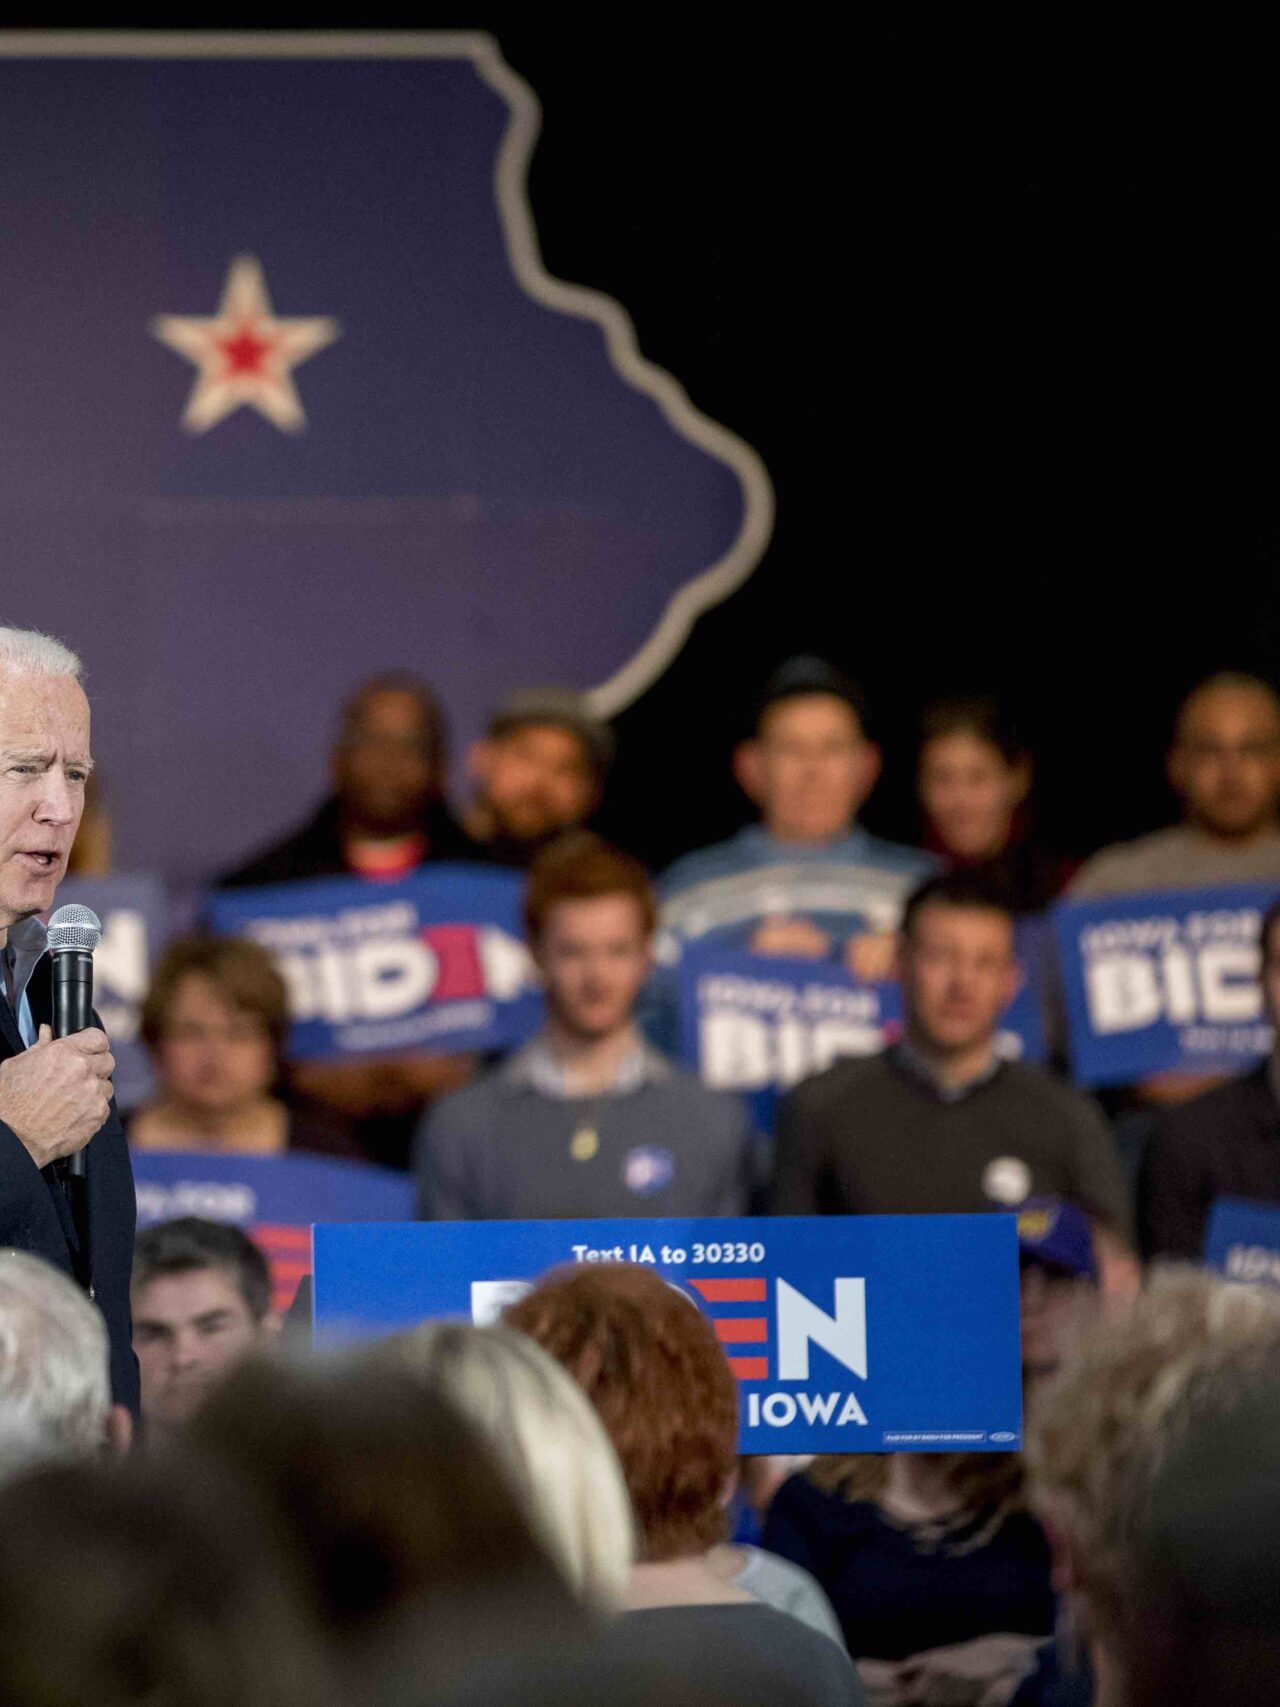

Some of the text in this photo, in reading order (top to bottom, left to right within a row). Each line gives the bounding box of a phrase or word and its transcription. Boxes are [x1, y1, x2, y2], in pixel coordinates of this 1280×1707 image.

[572, 1242, 766, 1263] Text IA to 30330
[748, 1392, 868, 1427] IOWA
